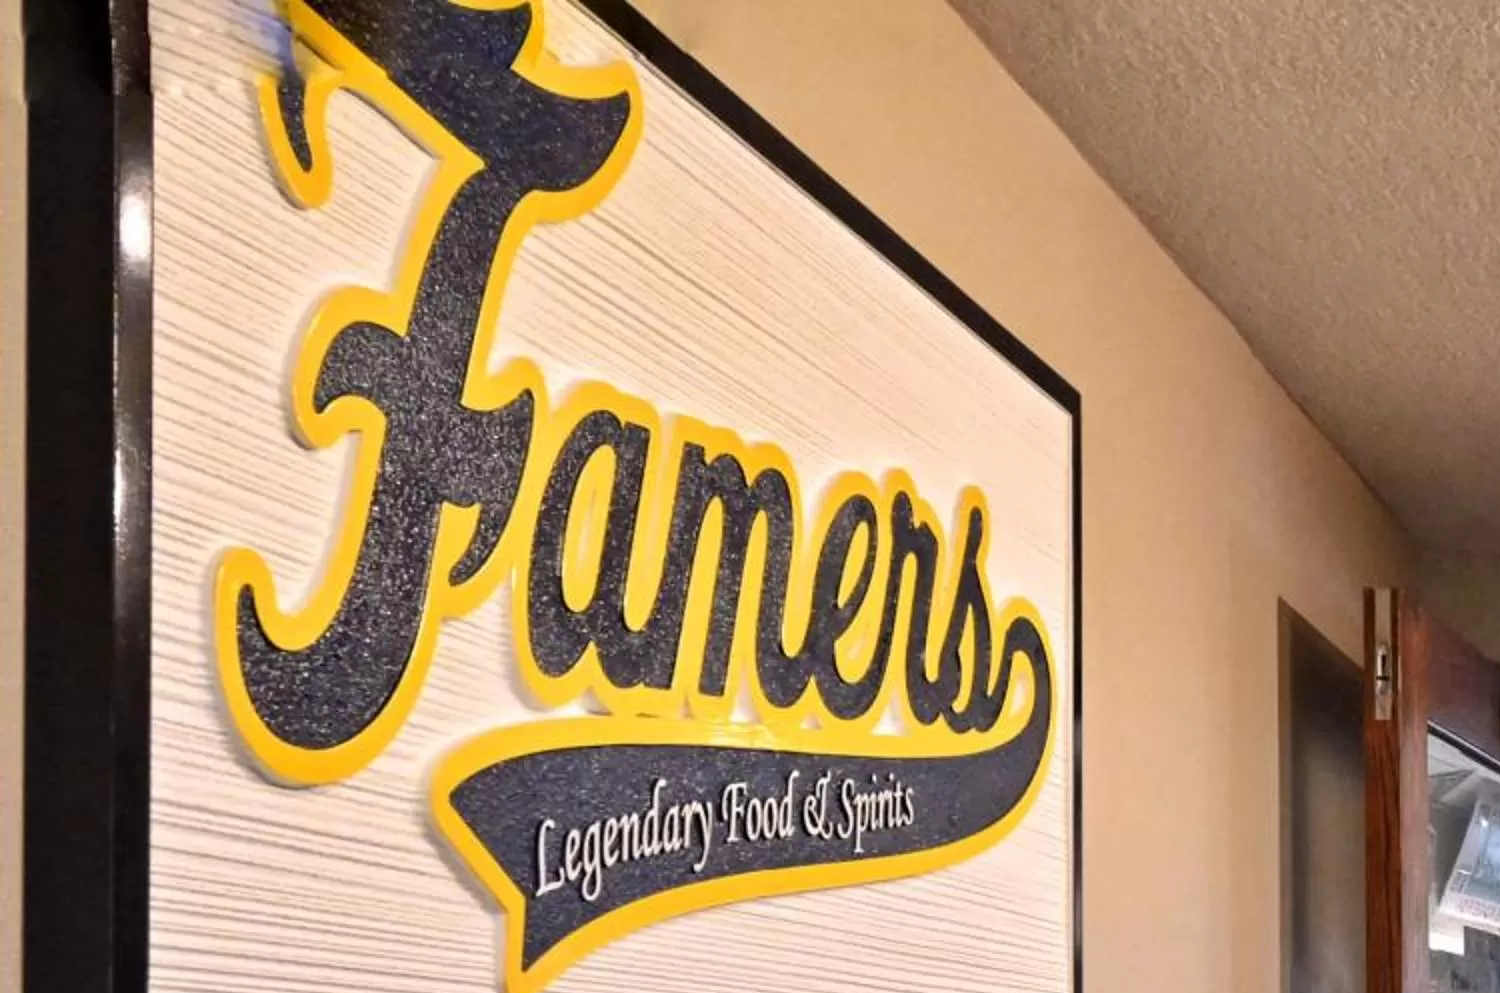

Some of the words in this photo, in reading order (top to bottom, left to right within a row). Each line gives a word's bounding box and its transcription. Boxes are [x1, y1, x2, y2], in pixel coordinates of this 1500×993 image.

[222, 0, 1042, 770] Famers
[535, 778, 714, 901] Legendary
[721, 770, 800, 844] Food
[803, 771, 837, 840] &
[837, 773, 917, 853] Spirits
